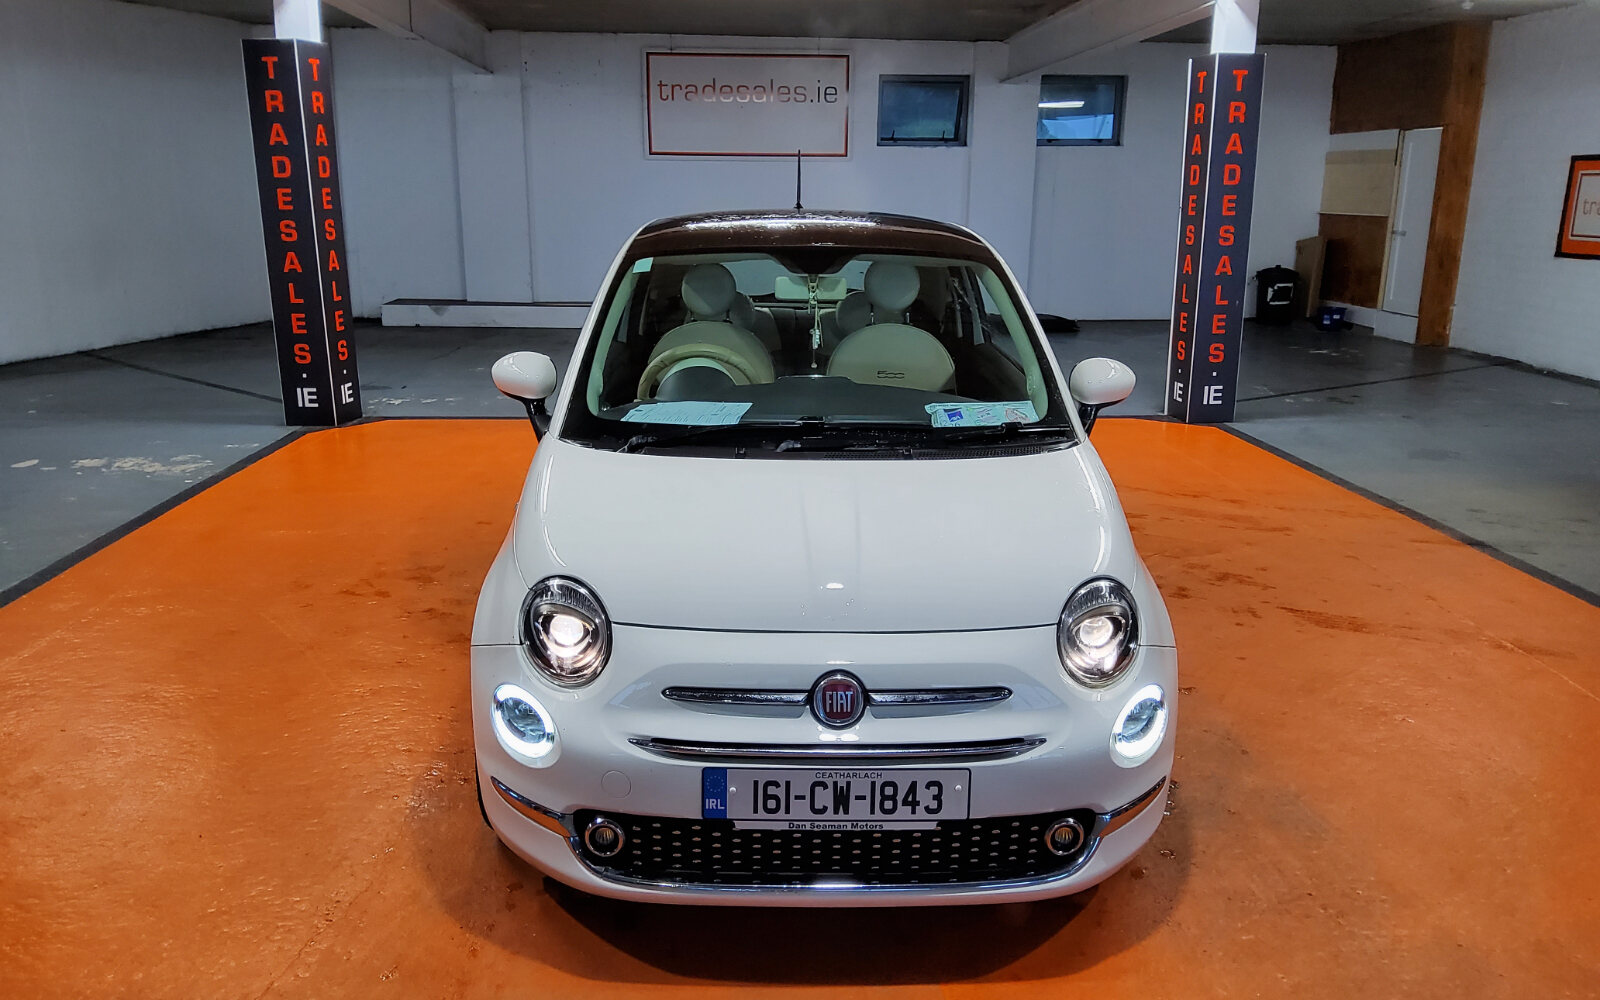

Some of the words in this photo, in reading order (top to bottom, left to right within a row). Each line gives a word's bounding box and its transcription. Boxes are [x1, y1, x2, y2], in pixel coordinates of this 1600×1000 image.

[657, 77, 838, 104] tradesales.ie
[261, 56, 319, 408] TRADESALES.IE
[308, 57, 354, 405] TRADESALES.IE
[1173, 71, 1208, 403] TRADESALES.IE
[1202, 69, 1249, 405] TRADESALES.IE
[825, 691, 853, 713] FIAT
[815, 771, 883, 779] CEATHARLACH
[705, 798, 726, 810] IRL
[752, 779, 944, 816] 161-CW-1843
[788, 822, 807, 830] Dan
[809, 822, 848, 830] Seaman
[850, 822, 884, 830] Motors
